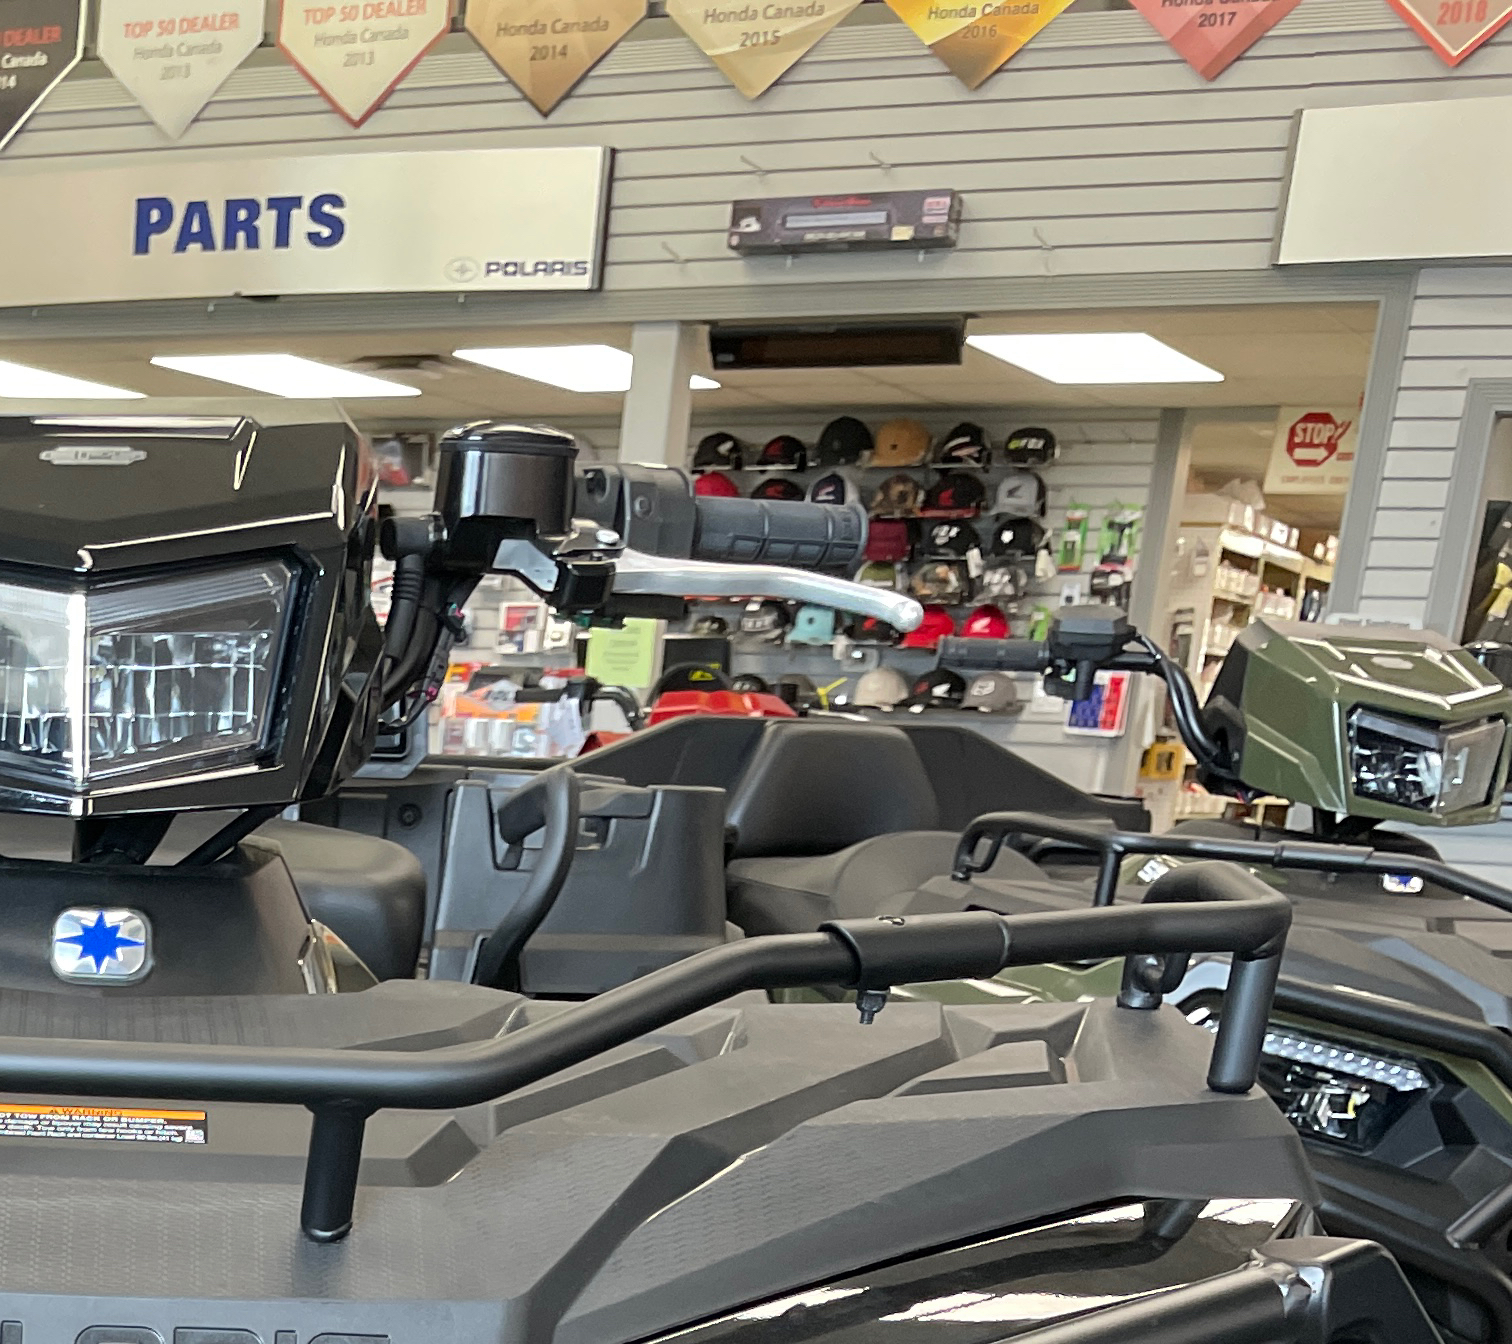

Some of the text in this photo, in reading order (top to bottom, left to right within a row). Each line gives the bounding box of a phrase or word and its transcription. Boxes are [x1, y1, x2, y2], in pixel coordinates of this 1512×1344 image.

[303, 7, 335, 25] TOP
[362, 0, 426, 20] DEALER
[704, 2, 824, 24] Honda Canada
[927, 2, 1040, 19] Honda Canada
[1198, 12, 1237, 28] 2017
[123, 12, 239, 39] TOP 50 DEALER
[496, 16, 609, 37] Honda Canada
[962, 24, 998, 40] 2016
[3, 25, 62, 47] DEALER
[740, 29, 780, 48] 2015
[1, 50, 48, 69] Canada
[529, 44, 568, 62] 2014
[132, 193, 346, 256] PARTS
[484, 259, 589, 278] POLARIS
